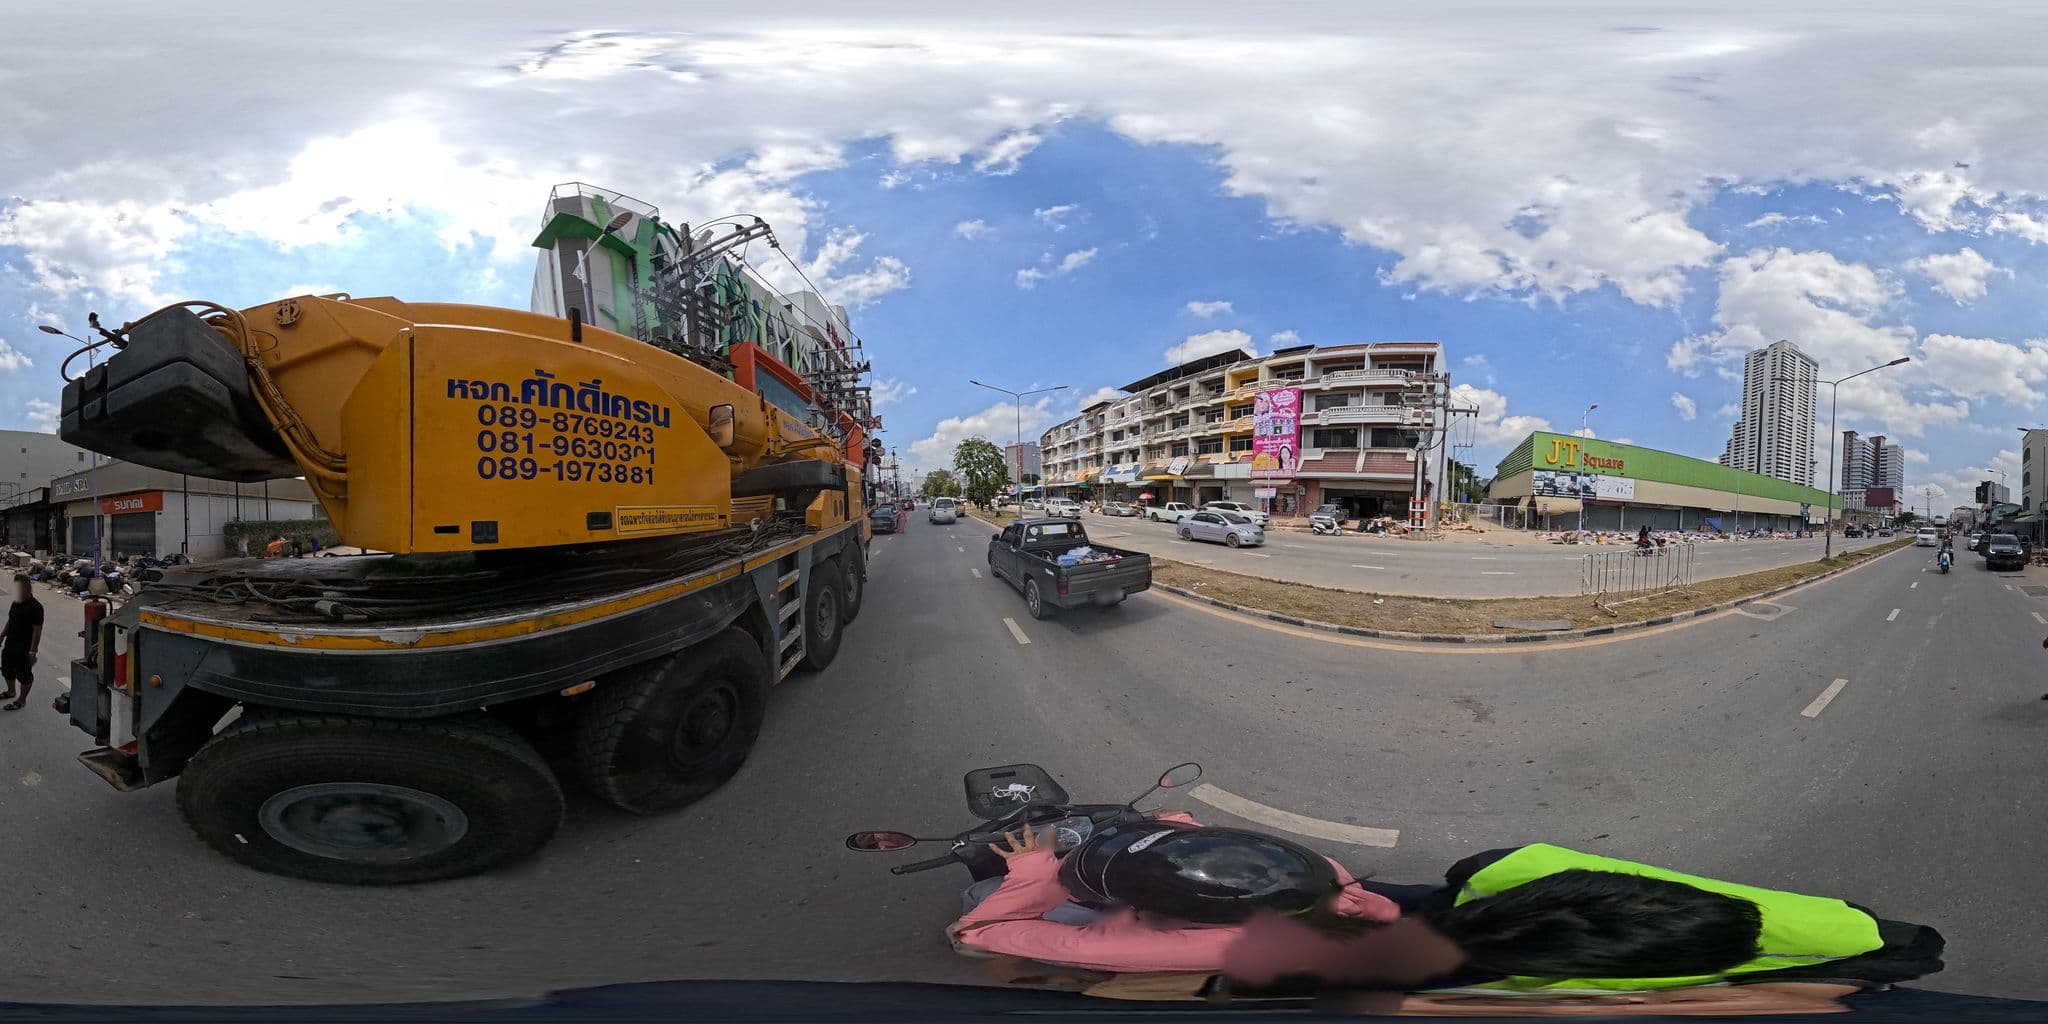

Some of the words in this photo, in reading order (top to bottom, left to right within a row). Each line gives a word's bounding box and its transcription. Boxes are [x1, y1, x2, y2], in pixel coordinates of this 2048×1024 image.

[478, 404, 655, 444] 089-8769243
[1546, 439, 1580, 466] JT
[1583, 453, 1624, 469] Square
[477, 456, 654, 485] 089-1973881
